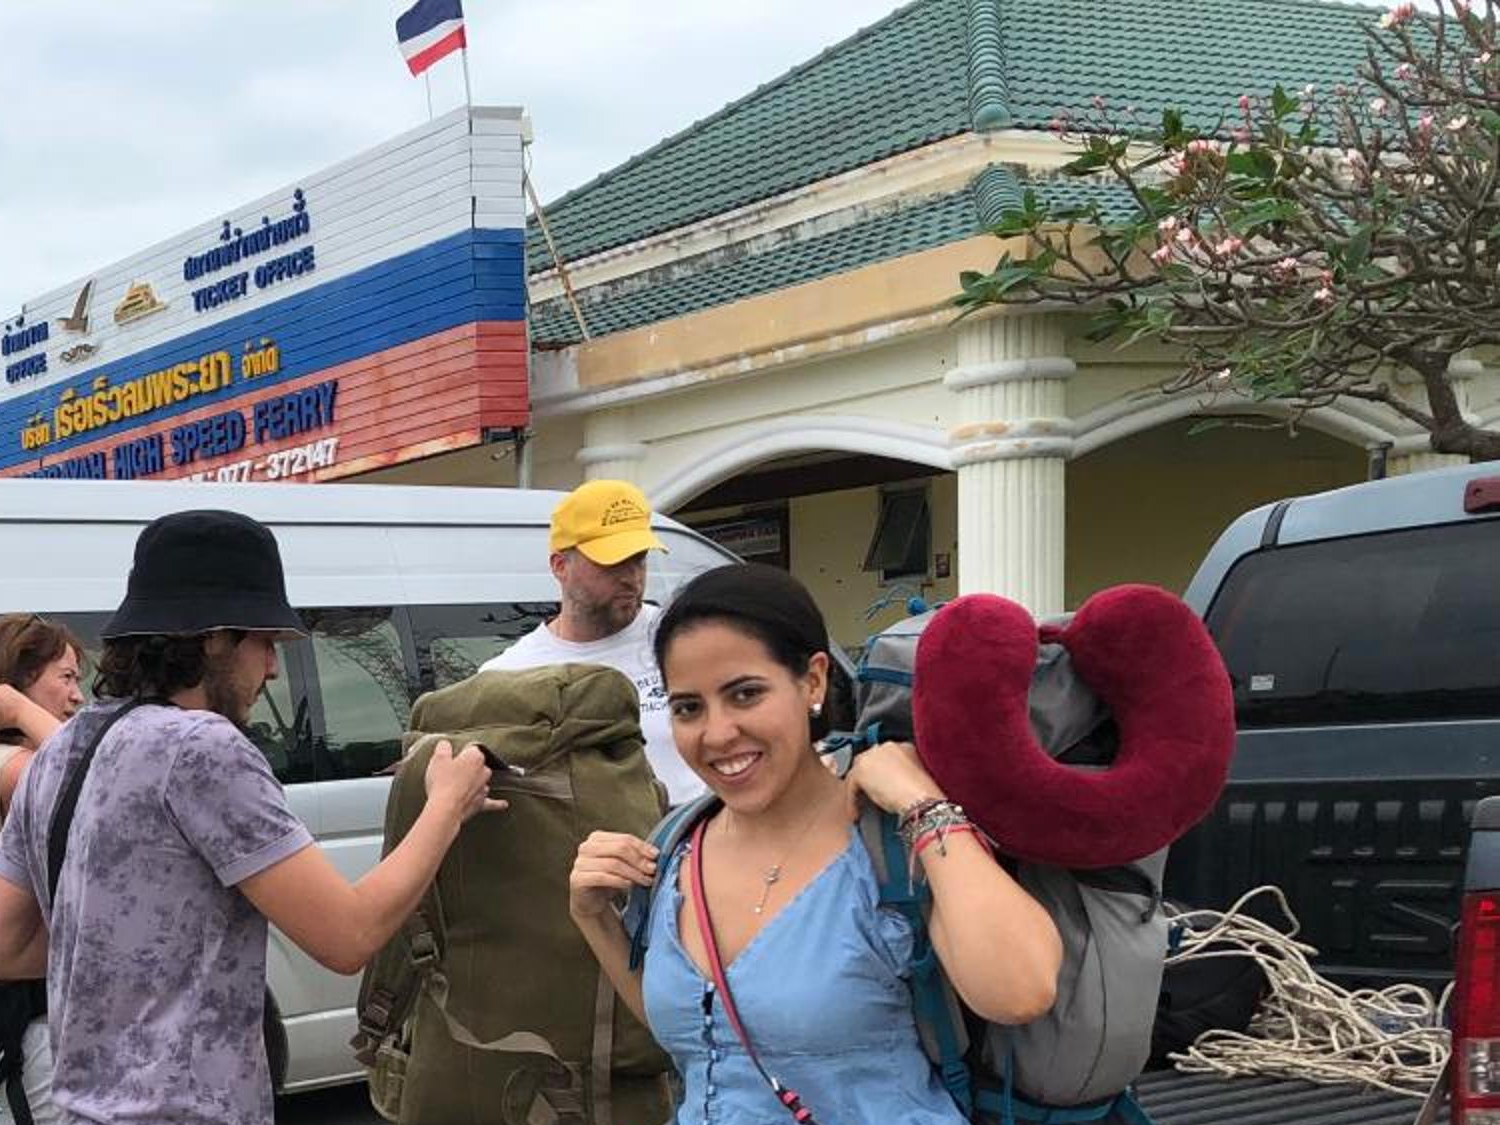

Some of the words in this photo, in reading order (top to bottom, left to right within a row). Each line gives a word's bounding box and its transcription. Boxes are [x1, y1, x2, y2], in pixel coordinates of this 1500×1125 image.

[191, 271, 249, 312] TICKET
[254, 245, 315, 289] OFFICE
[5, 352, 48, 384] OFFICE
[113, 432, 165, 480] HIGH
[170, 411, 246, 466] SPEED
[253, 378, 338, 444] FERRY
